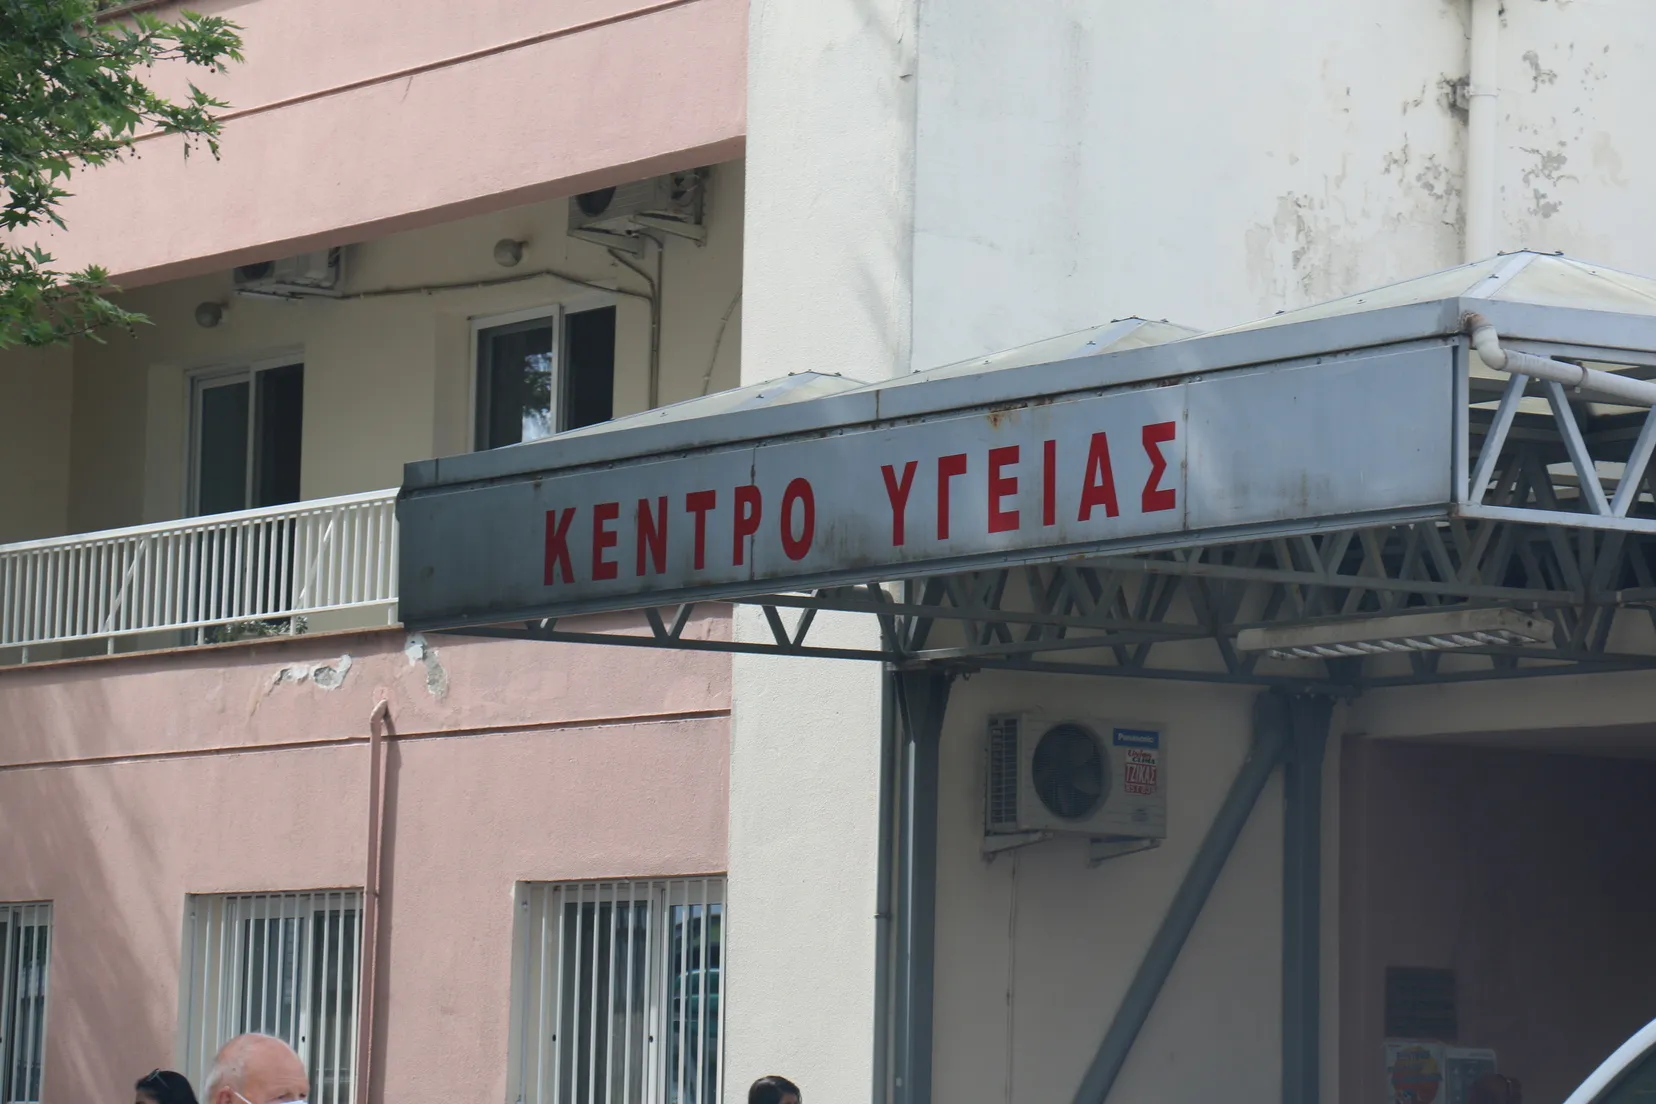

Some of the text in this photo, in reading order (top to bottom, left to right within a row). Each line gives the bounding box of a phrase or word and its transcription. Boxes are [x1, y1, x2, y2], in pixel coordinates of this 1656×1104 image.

[543, 421, 1176, 587] ΚΕΝΤΡΟ ΥΓΕΙΑΣ
[1117, 732, 1155, 743] Panasonic
[1125, 763, 1156, 785] ΤΖΙΚΑΣ
